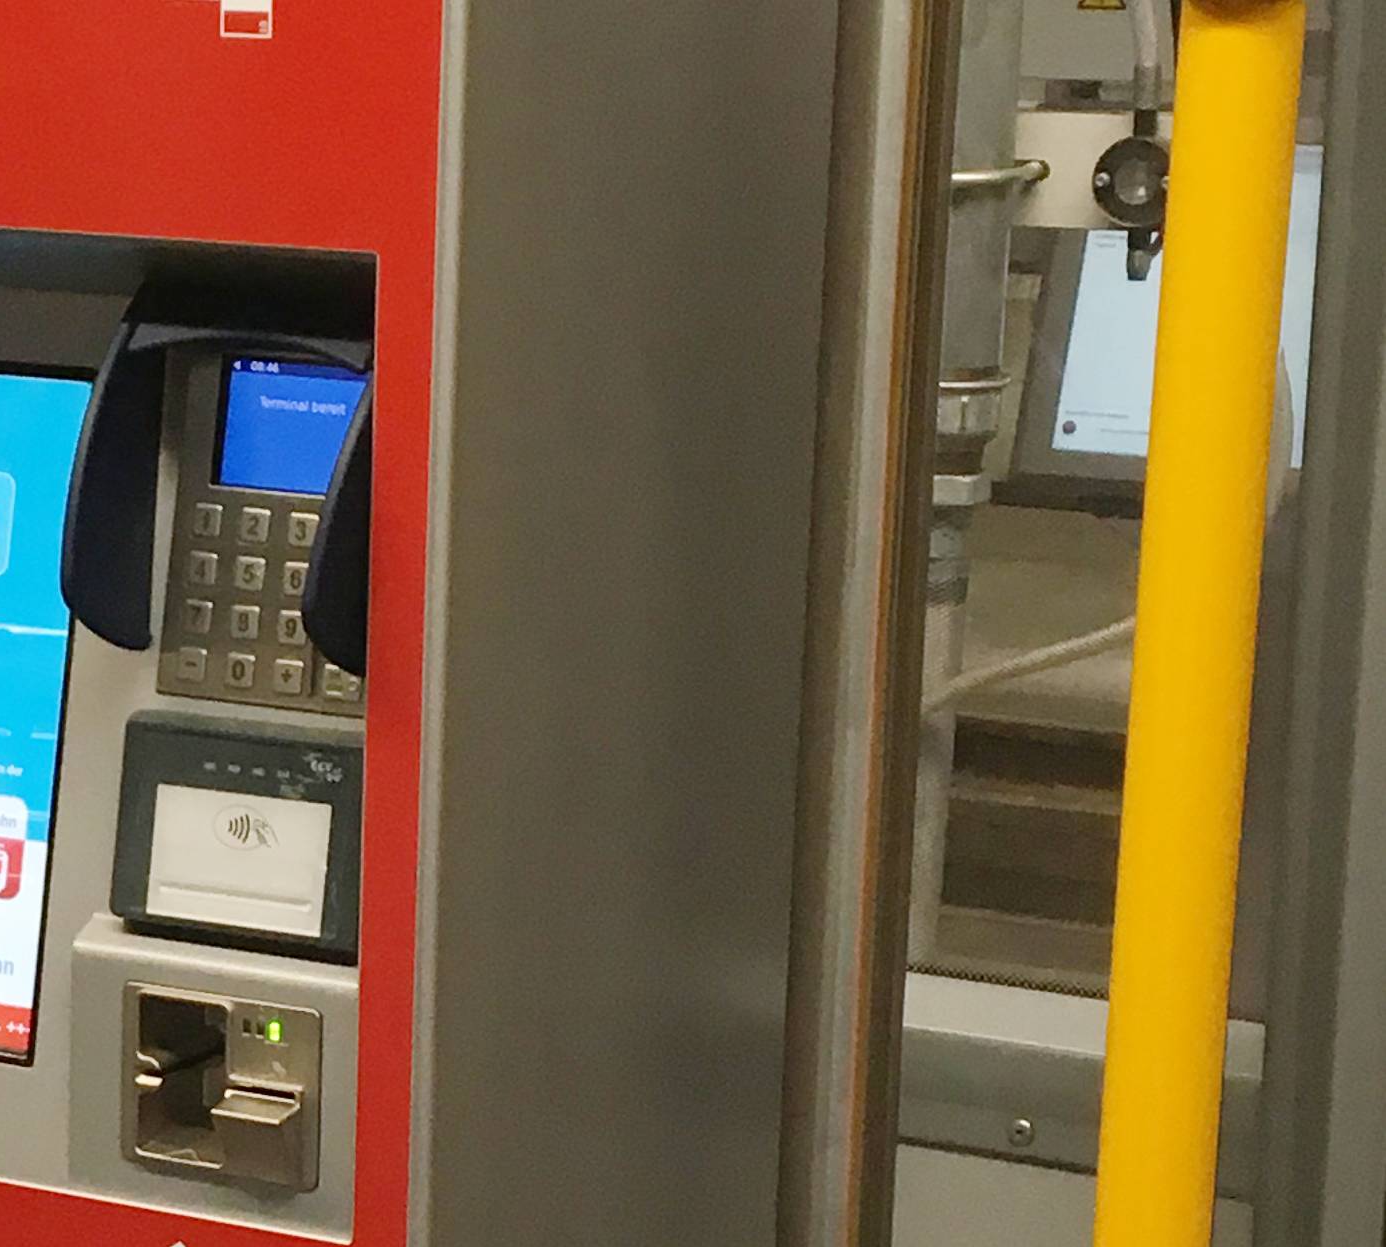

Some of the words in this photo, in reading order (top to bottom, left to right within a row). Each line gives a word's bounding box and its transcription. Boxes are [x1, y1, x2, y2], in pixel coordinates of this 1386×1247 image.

[260, 395, 310, 412] Terminal
[311, 401, 346, 416] bereit
[247, 516, 259, 536] 2
[296, 521, 307, 541] 3
[194, 559, 206, 578] 4
[243, 564, 255, 584] 5
[290, 569, 302, 589] 6
[191, 606, 202, 625] 7
[237, 613, 249, 632] 8
[285, 618, 297, 638] 9
[231, 660, 245, 681] 0
